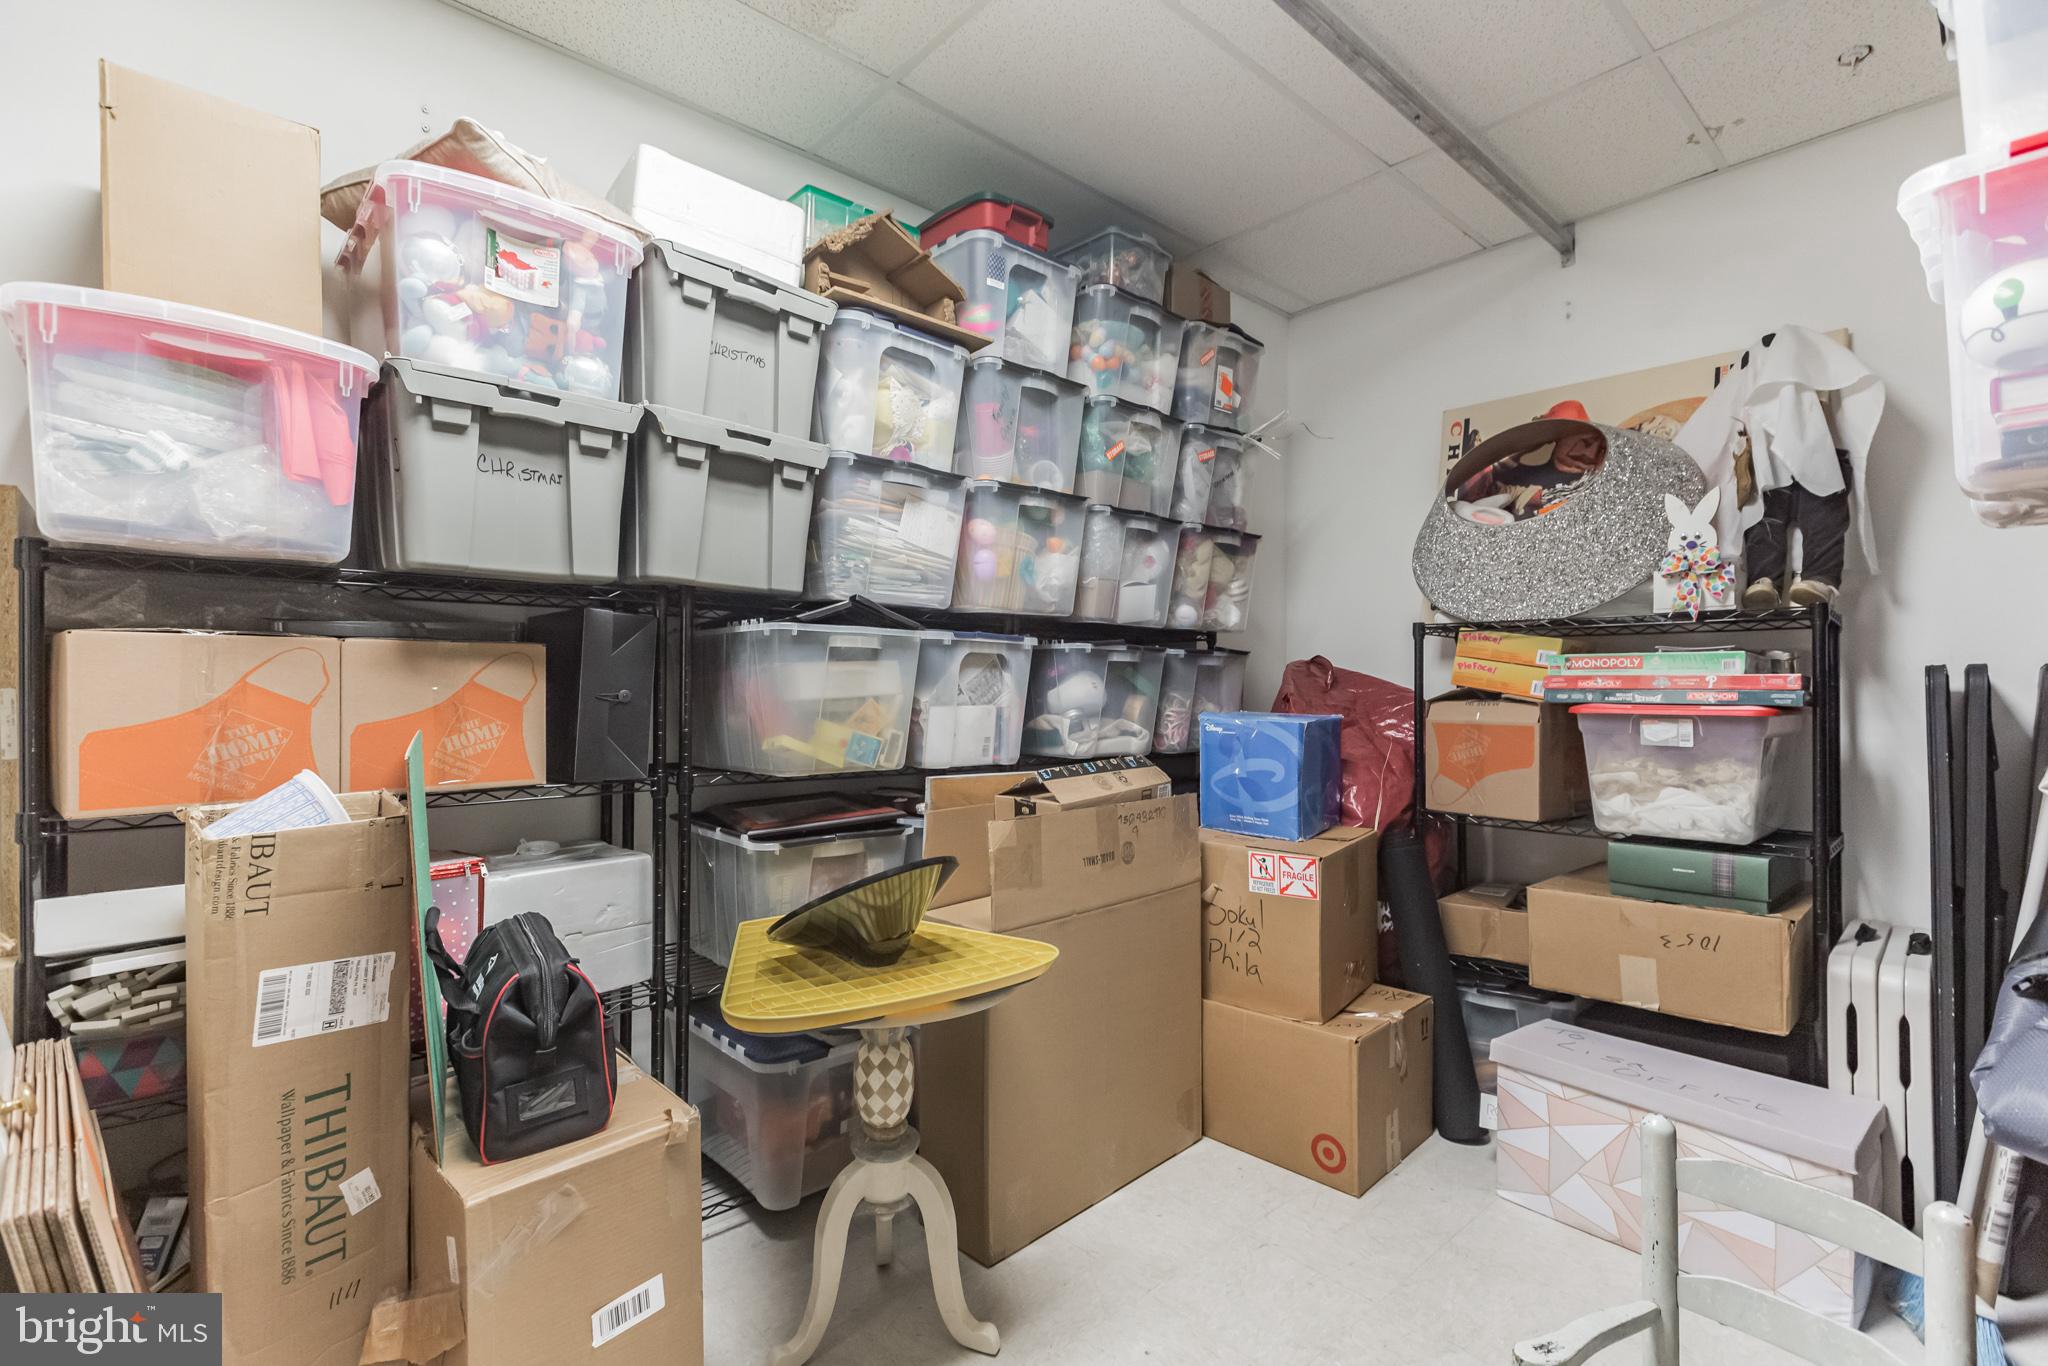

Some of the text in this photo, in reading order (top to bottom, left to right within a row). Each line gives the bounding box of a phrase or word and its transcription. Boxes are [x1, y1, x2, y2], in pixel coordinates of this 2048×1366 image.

[1571, 657, 1640, 669] MONOPOLY
[1282, 870, 1314, 882] FRAGILE
[277, 1088, 296, 1285] Wallpaper & Fabrics Since 1886
[304, 1072, 351, 1267] THIBAUT
